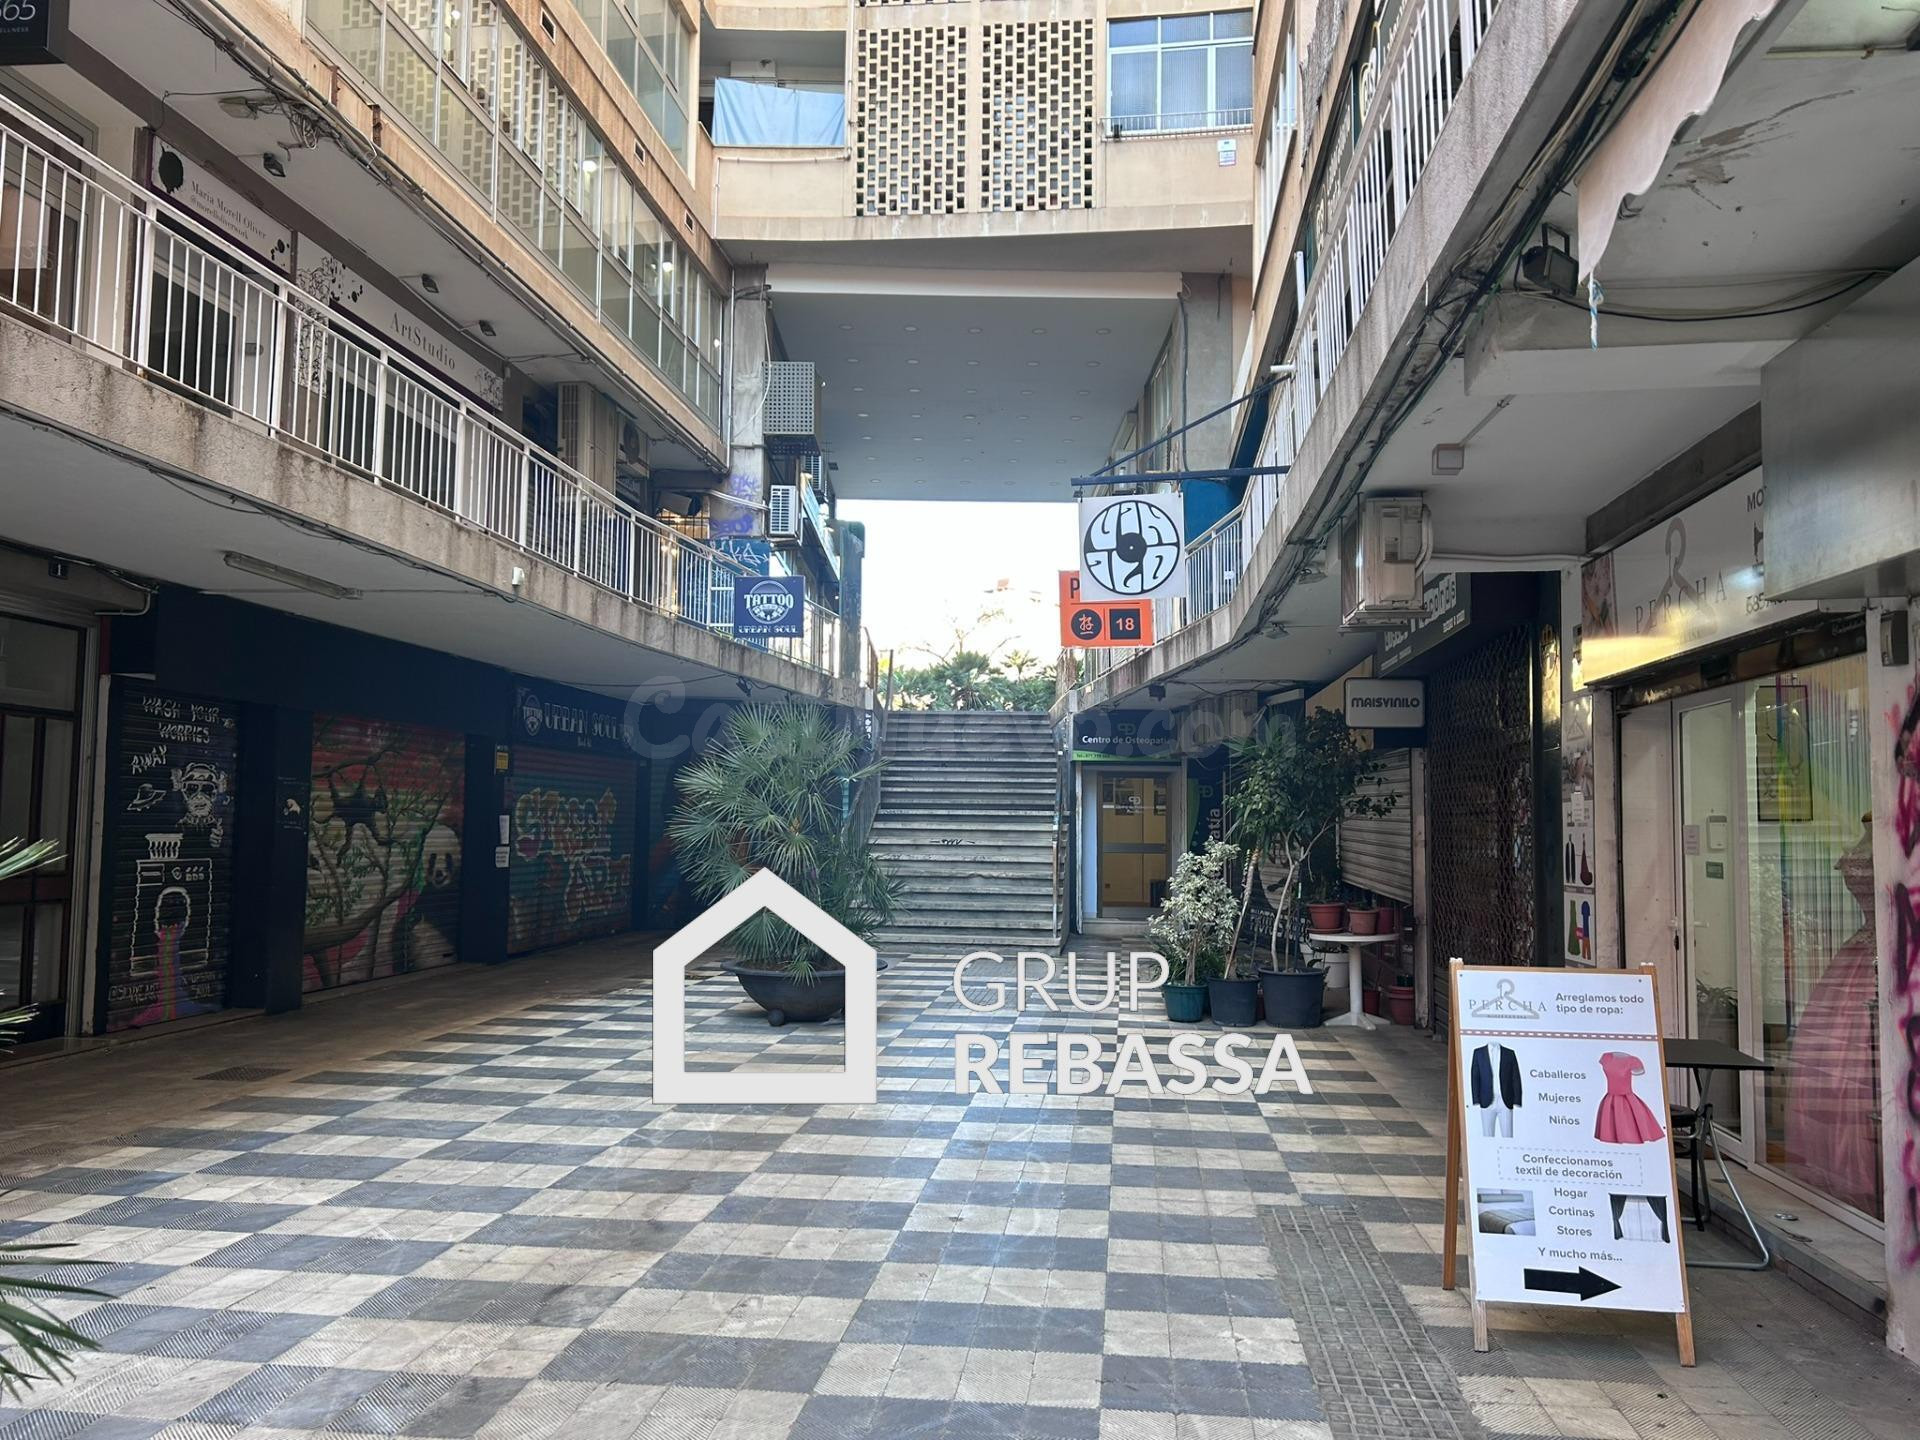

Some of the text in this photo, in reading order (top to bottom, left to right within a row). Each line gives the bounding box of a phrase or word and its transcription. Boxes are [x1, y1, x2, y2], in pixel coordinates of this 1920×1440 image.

[0, 0, 36, 20] 65
[390, 312, 456, 369] ArtStudio
[1746, 486, 1767, 512] MO
[743, 593, 794, 609] TATTOO
[1635, 568, 1727, 634] PERCHA
[738, 625, 799, 634] URBAN SOUL
[1115, 617, 1135, 631] 18
[142, 696, 220, 723] WASH YOUR
[159, 722, 210, 743] WORRIES
[1082, 735, 1111, 744] Centro
[1112, 736, 1124, 744] de
[131, 744, 167, 775] AWAY
[1555, 992, 1645, 1005] Arreglamos todo
[1469, 999, 1548, 1012] PERCHA
[1556, 1003, 1624, 1016] tipo de ropa:
[1529, 1068, 1587, 1080] Caballeros
[1538, 1092, 1582, 1104] Mujeres
[1548, 1115, 1581, 1126] Niños
[1522, 1154, 1614, 1167] Confeccionamos
[1515, 1166, 1623, 1180] textil de decoración
[1553, 1187, 1588, 1200] Hogar
[1548, 1205, 1596, 1218] Cortinas
[1556, 1225, 1593, 1237] Stores
[1537, 1246, 1623, 1262] Y mucho más...
